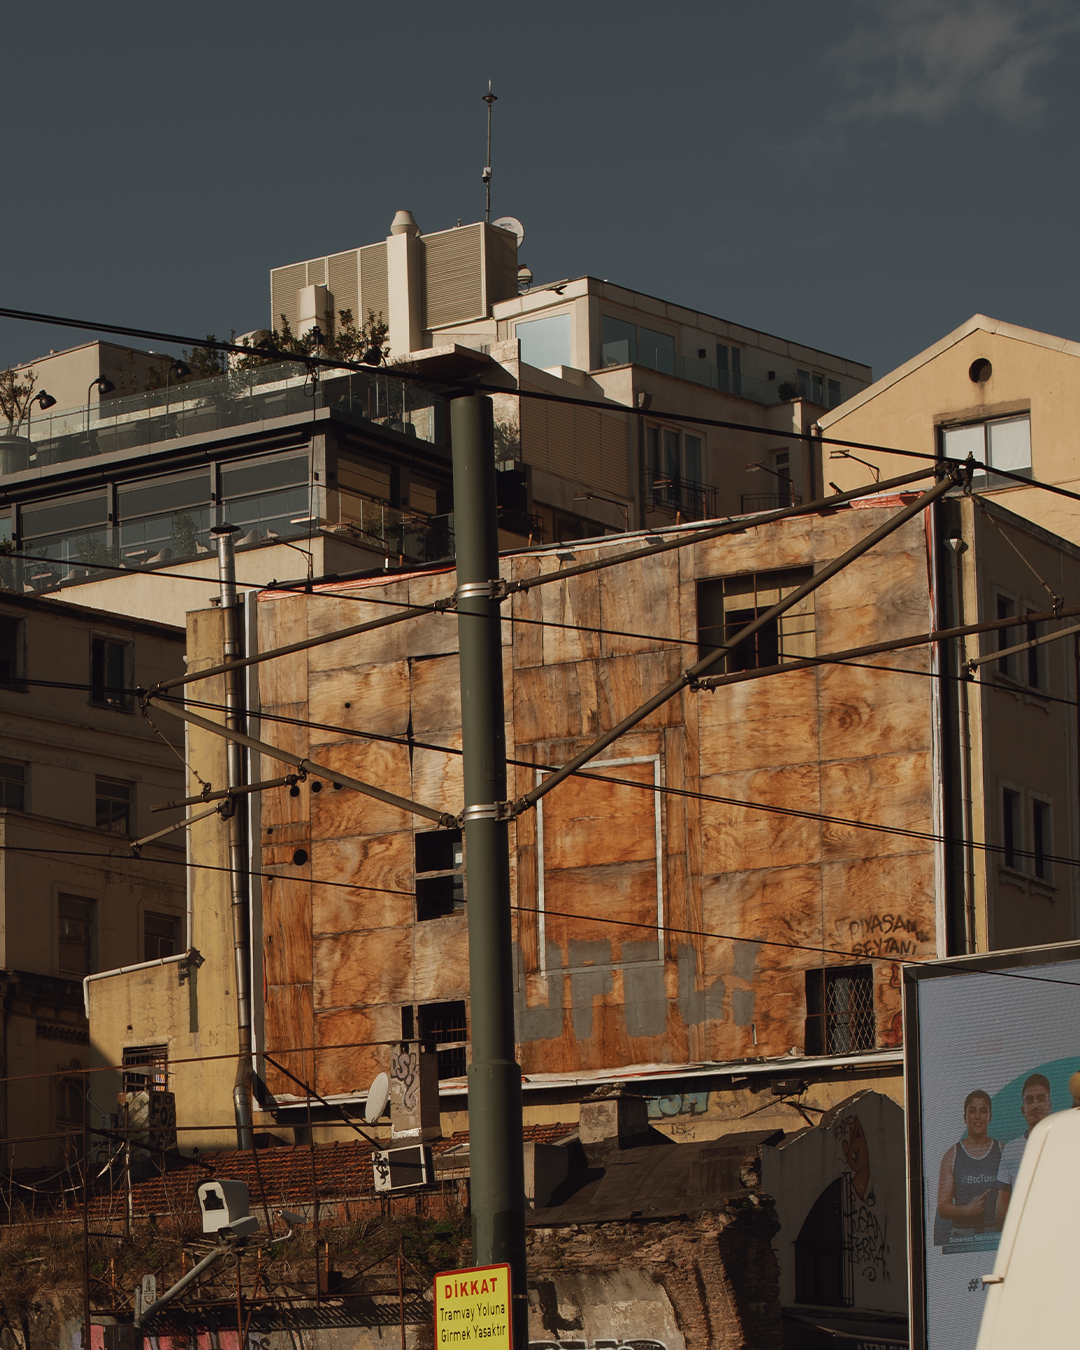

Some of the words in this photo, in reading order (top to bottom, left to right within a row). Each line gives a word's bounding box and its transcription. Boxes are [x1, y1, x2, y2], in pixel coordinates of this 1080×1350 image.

[444, 1277, 498, 1299] DİKKAT
[440, 1306, 475, 1322] Tramvay
[477, 1303, 506, 1317] Yoluna
[441, 1326, 471, 1342] Girmek
[473, 1324, 506, 1340] Yasaktır
